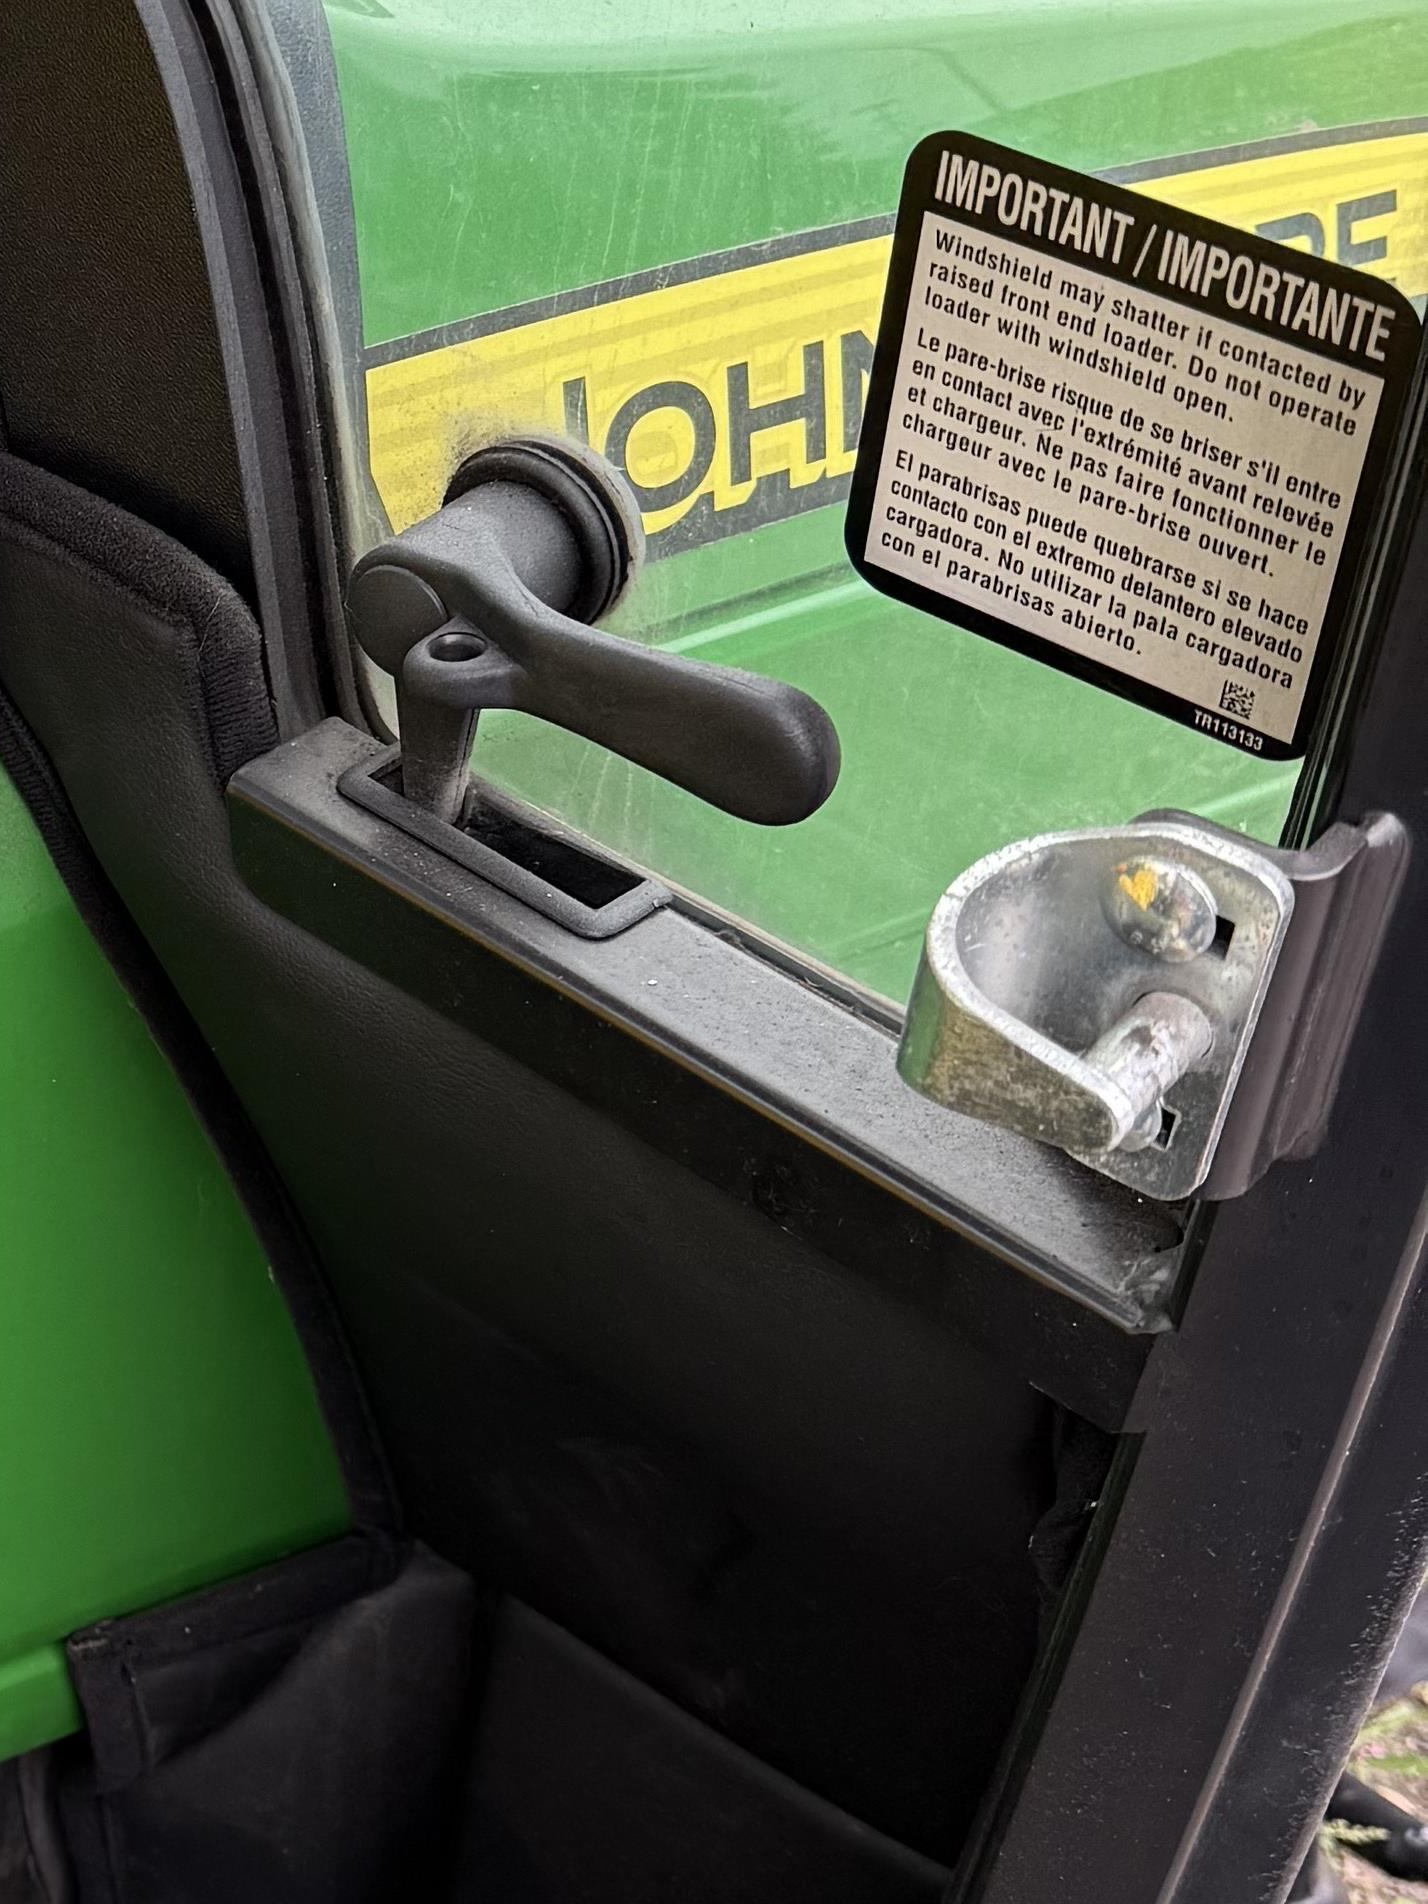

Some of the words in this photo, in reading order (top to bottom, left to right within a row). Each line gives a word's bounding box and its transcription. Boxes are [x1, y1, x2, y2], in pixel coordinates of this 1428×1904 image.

[934, 150, 1136, 265] IMPORTANT
[1157, 229, 1396, 363] IMPORTANTE
[936, 229, 1053, 290] Windshield
[1059, 280, 1105, 313] may
[1111, 298, 1190, 341] shatter
[1196, 326, 1213, 350] if
[1219, 339, 1332, 395] contacted
[1338, 378, 1366, 411] by
[917, 327, 940, 353] Le
[944, 342, 1046, 394] pare-brise
[1051, 382, 1114, 420] risque
[1120, 407, 1145, 432] de
[1150, 422, 1174, 444] se
[1180, 429, 1243, 471] briser
[1246, 459, 1280, 486] s'il
[1285, 475, 1341, 510] entre
[925, 285, 991, 327] loader
[997, 317, 1041, 347] with
[1049, 336, 1167, 395] windshield
[1173, 385, 1233, 423] open.
[929, 262, 994, 299] raised
[1000, 284, 1050, 321] front
[1057, 310, 1097, 337] end
[1103, 322, 1177, 370] loader.
[1188, 354, 1218, 384] Do
[1225, 373, 1261, 401] not
[1268, 390, 1357, 436] operate
[902, 413, 993, 460] chargeur
[998, 452, 1046, 483] avec
[1053, 469, 1072, 493] le
[1078, 484, 1191, 542] pare-brise
[1198, 533, 1274, 578] ouvert.
[907, 387, 927, 407] et
[932, 396, 1026, 447] chargeur.
[1036, 433, 1063, 460] Ne
[1070, 451, 1108, 478] pas
[1115, 465, 1164, 501] faire
[1172, 487, 1300, 555] fonctionner
[1305, 540, 1326, 566] le
[912, 359, 936, 381] en
[941, 371, 1013, 411] contact
[1018, 400, 1065, 431] avec
[1071, 416, 1182, 478] l'extrémité
[1188, 468, 1247, 505] avant
[1252, 493, 1334, 538] relevée
[881, 532, 915, 557] con
[922, 549, 941, 569] el
[946, 560, 1055, 617] parabrisas
[1061, 608, 1141, 655] abierto.
[886, 506, 989, 562] cargadora.
[997, 548, 1024, 576] No
[1031, 566, 1103, 608] utilizar
[1107, 594, 1127, 620] la
[1132, 609, 1179, 641] pala
[1185, 632, 1293, 690] cargadora
[891, 480, 968, 523] contacto
[973, 514, 1007, 540] con
[1013, 530, 1032, 550] el
[1036, 540, 1115, 585] extremo
[1120, 573, 1216, 627] delantero
[1221, 617, 1303, 664] elevado
[895, 449, 914, 473] El
[918, 462, 1021, 516] parabrisas
[1026, 507, 1088, 544] puede
[1093, 534, 1196, 589] quebrarse
[1201, 579, 1222, 600] si
[1226, 590, 1252, 612] se
[1257, 597, 1309, 636] hace
